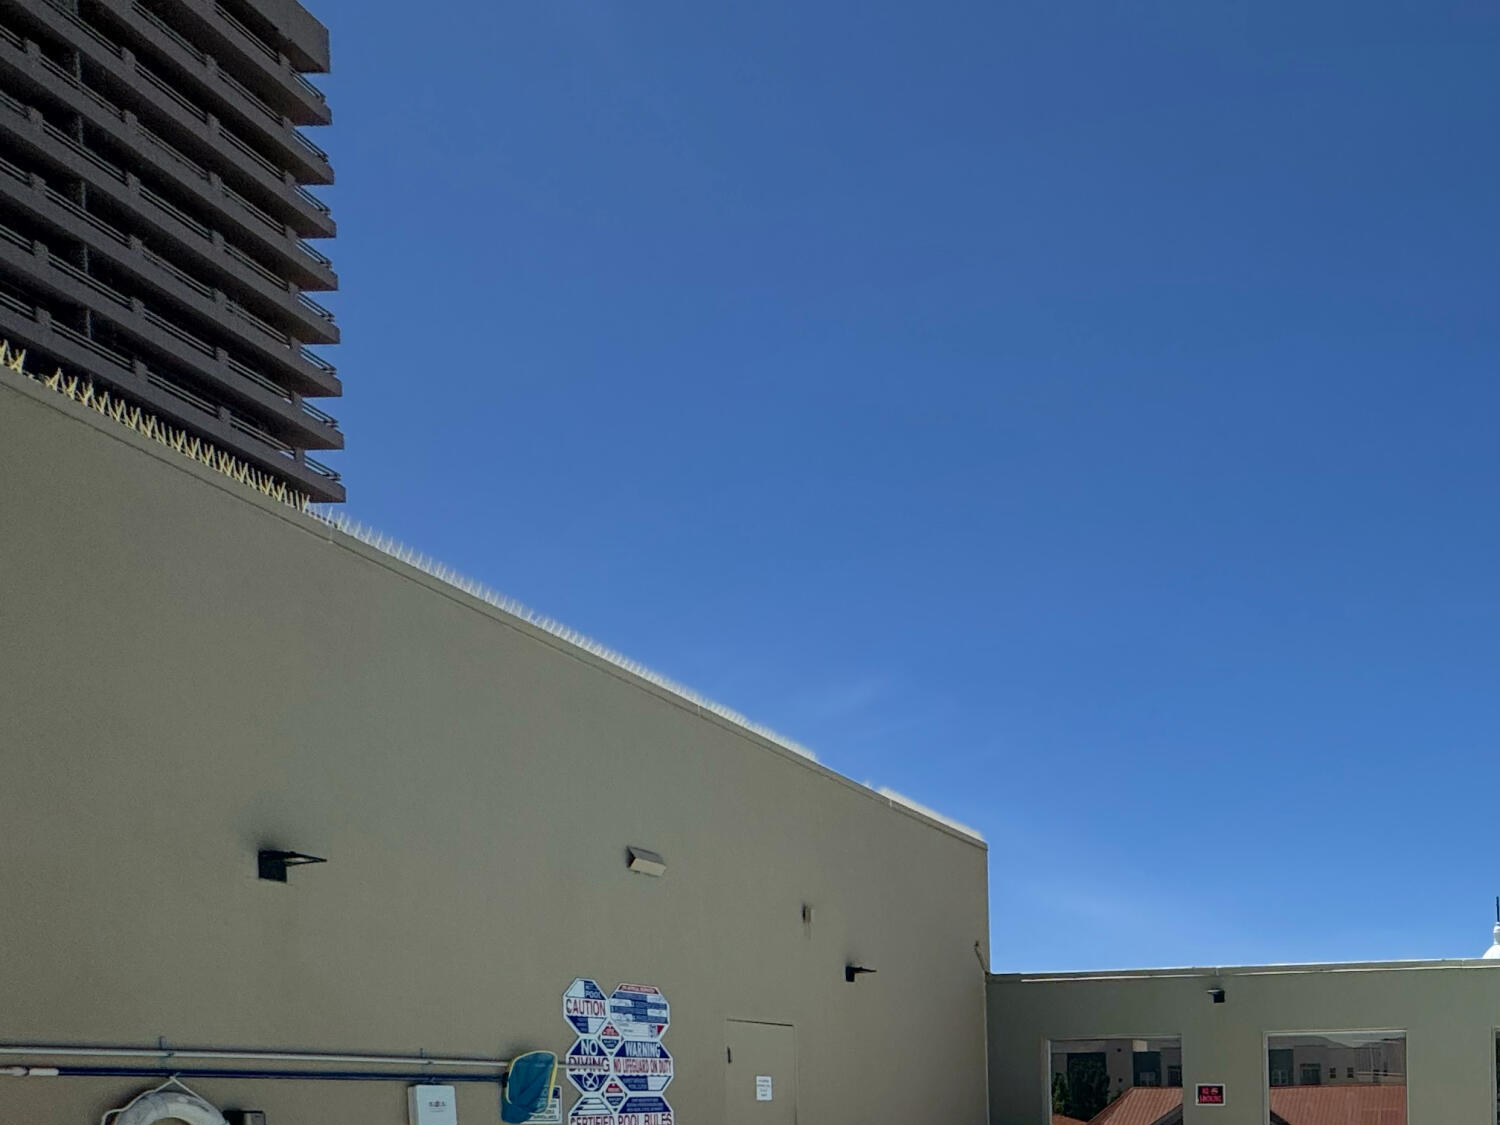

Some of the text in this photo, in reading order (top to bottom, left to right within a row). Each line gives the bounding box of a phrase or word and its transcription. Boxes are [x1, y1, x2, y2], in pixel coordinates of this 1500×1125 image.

[565, 998, 606, 1016] CAUTION
[581, 1039, 599, 1056] NO
[625, 1041, 661, 1058] WARNING
[568, 1056, 610, 1072] DIVING
